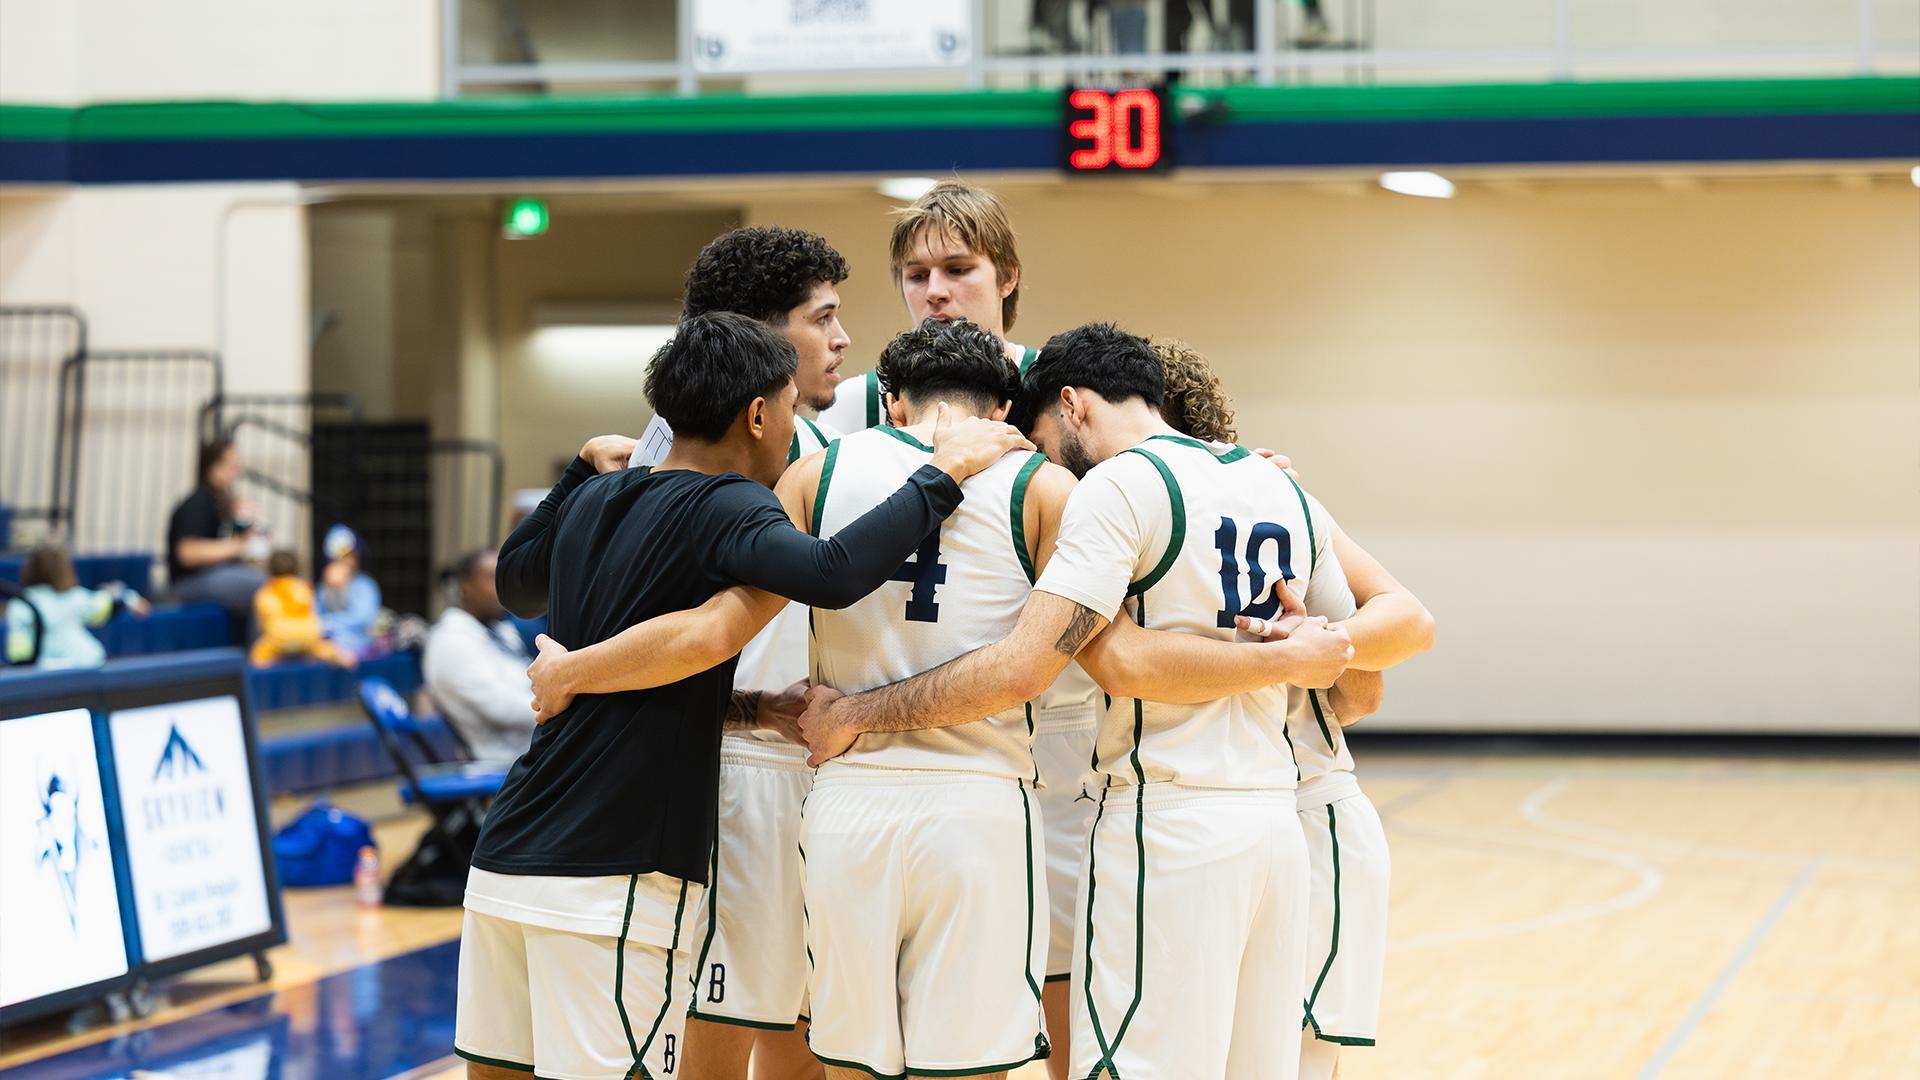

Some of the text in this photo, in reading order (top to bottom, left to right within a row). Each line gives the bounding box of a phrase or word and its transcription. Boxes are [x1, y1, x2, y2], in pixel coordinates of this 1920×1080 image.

[1069, 89, 1160, 169] 30
[887, 520, 948, 623] 4
[1214, 516, 1296, 629] 10
[707, 963, 726, 1003] B
[662, 1033, 676, 1075] B
